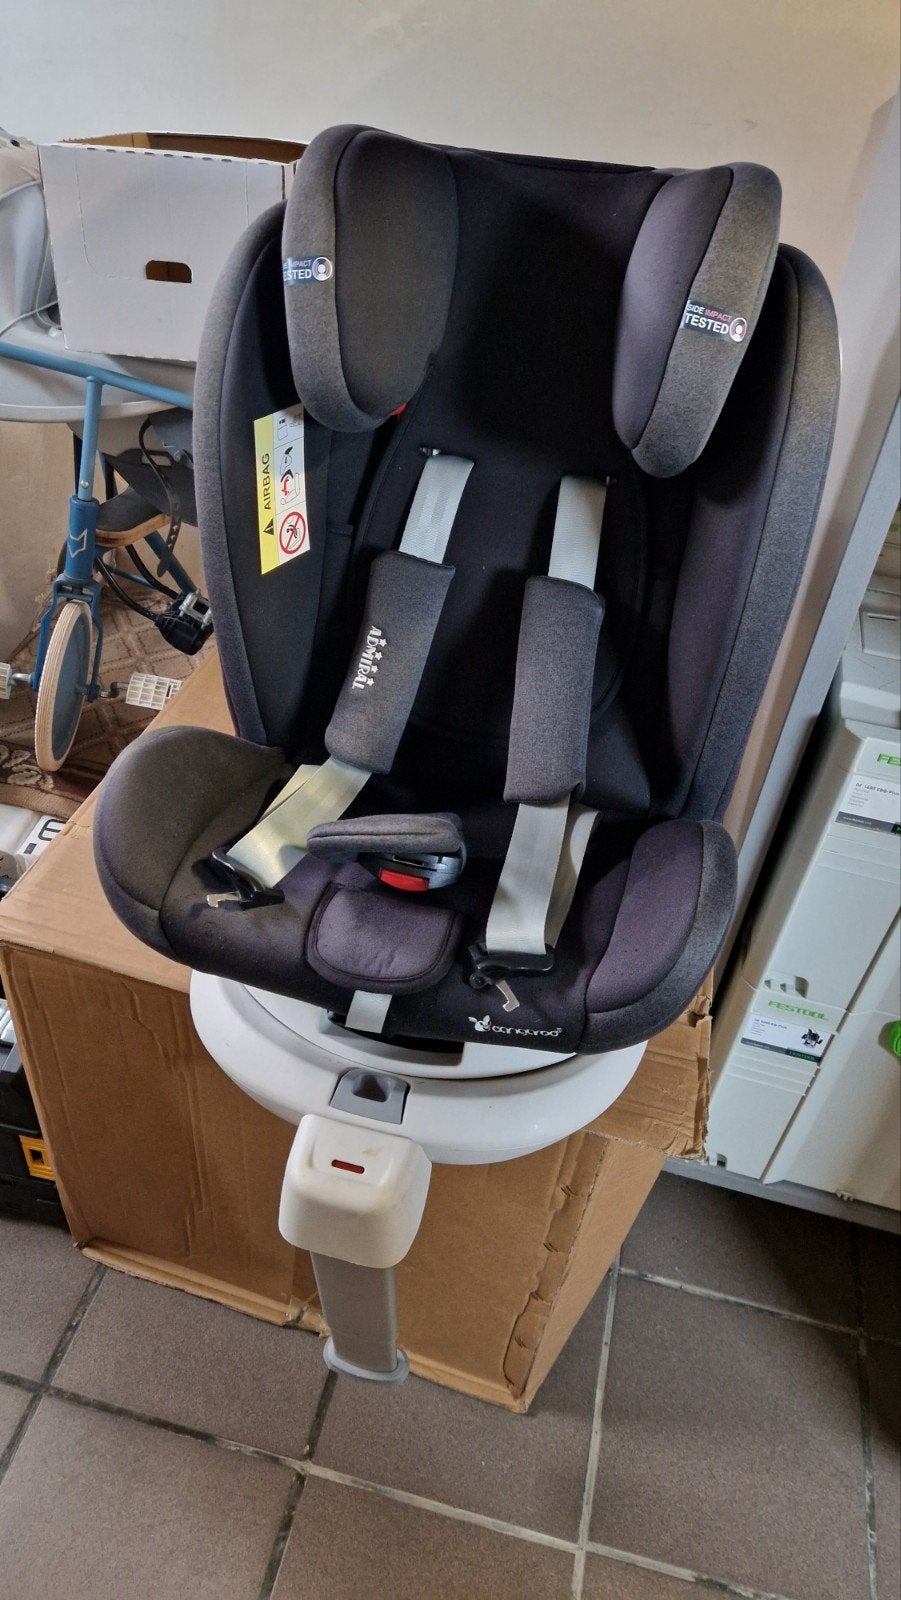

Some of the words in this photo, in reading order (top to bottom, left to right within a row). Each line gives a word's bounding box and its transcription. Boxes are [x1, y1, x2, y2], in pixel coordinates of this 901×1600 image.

[283, 269, 312, 281] ESTED
[685, 312, 729, 334] TESTED
[686, 303, 705, 315] SIDE
[704, 308, 732, 322] IMPACT
[261, 453, 271, 510] AIRBAG
[352, 625, 382, 689] ADMIRAL
[768, 1000, 826, 1020] FESTOOL
